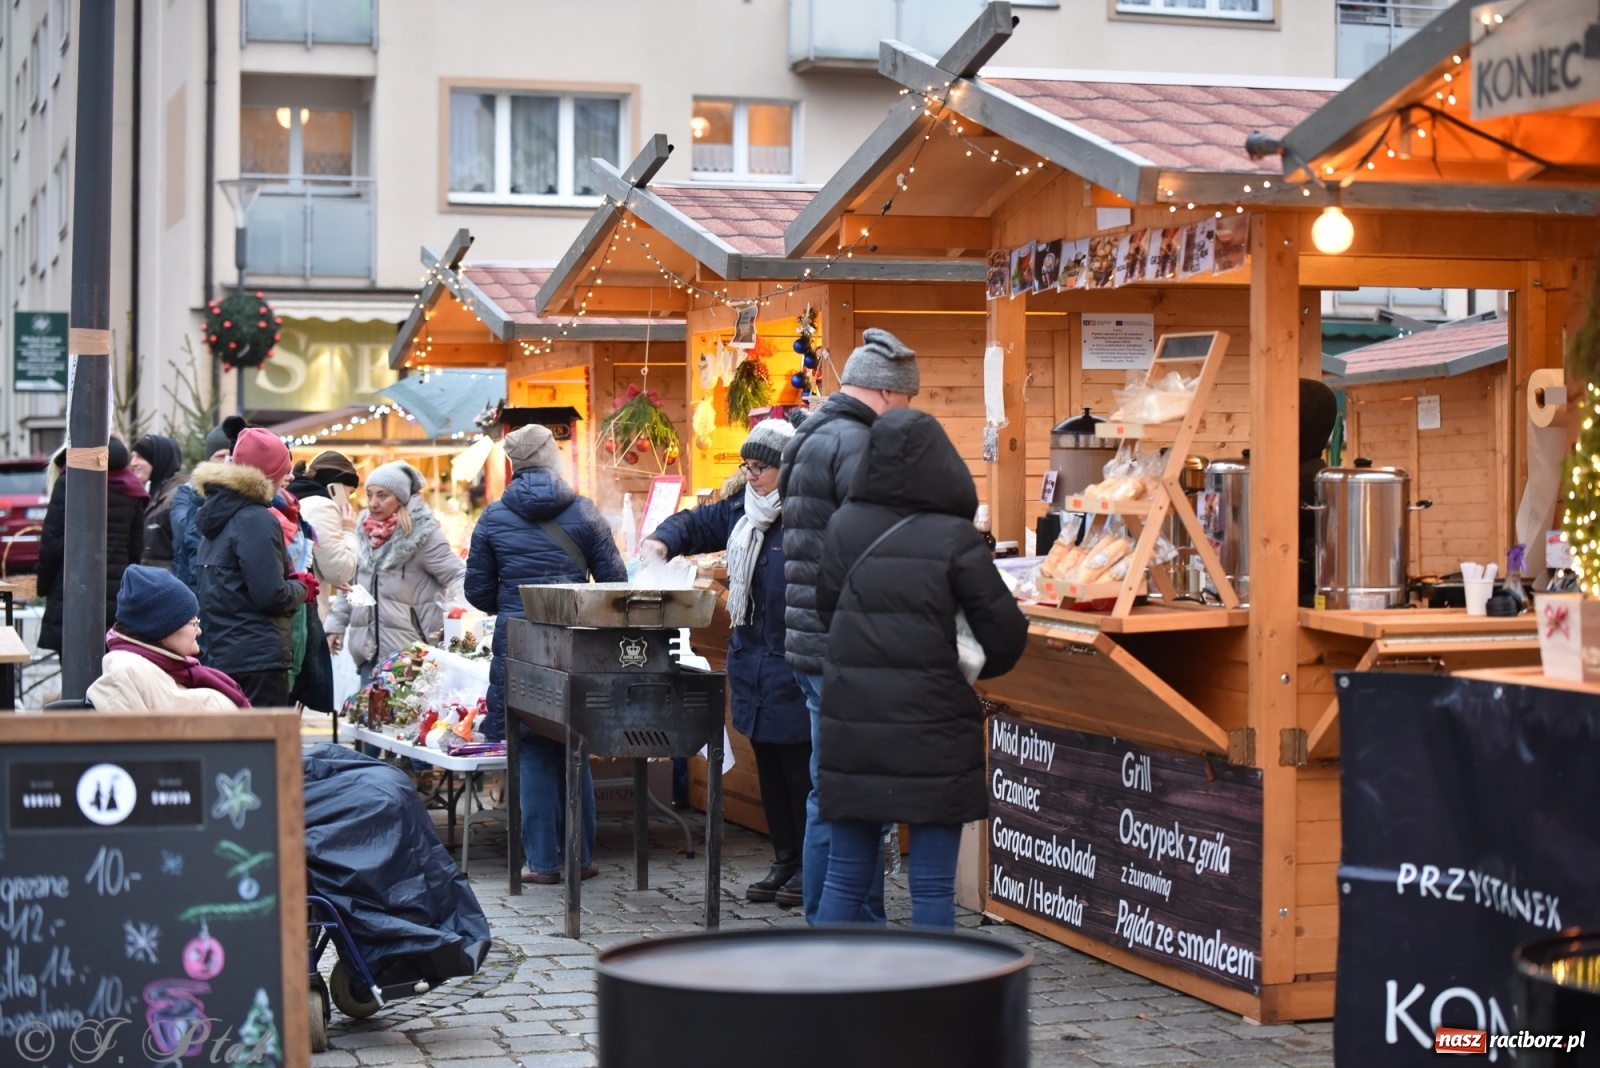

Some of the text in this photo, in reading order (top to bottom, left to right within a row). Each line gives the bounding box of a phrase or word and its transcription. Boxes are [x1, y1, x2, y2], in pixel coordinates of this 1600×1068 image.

[1477, 42, 1582, 110] KONIEC
[992, 719, 1056, 771] Miód pitny
[1121, 751, 1152, 793] Grill
[992, 768, 1041, 812] Grzaniec
[992, 817, 1096, 880] Gorąca czekolada
[1118, 808, 1185, 862] Oscypek
[1187, 835, 1196, 863] z
[993, 864, 1024, 905] Kawa
[1033, 881, 1084, 928] Herbata
[1121, 862, 1172, 902] z żurawiną
[1397, 862, 1562, 932] PRZYSTANEK
[1115, 899, 1254, 980] Pajda ze smalcem
